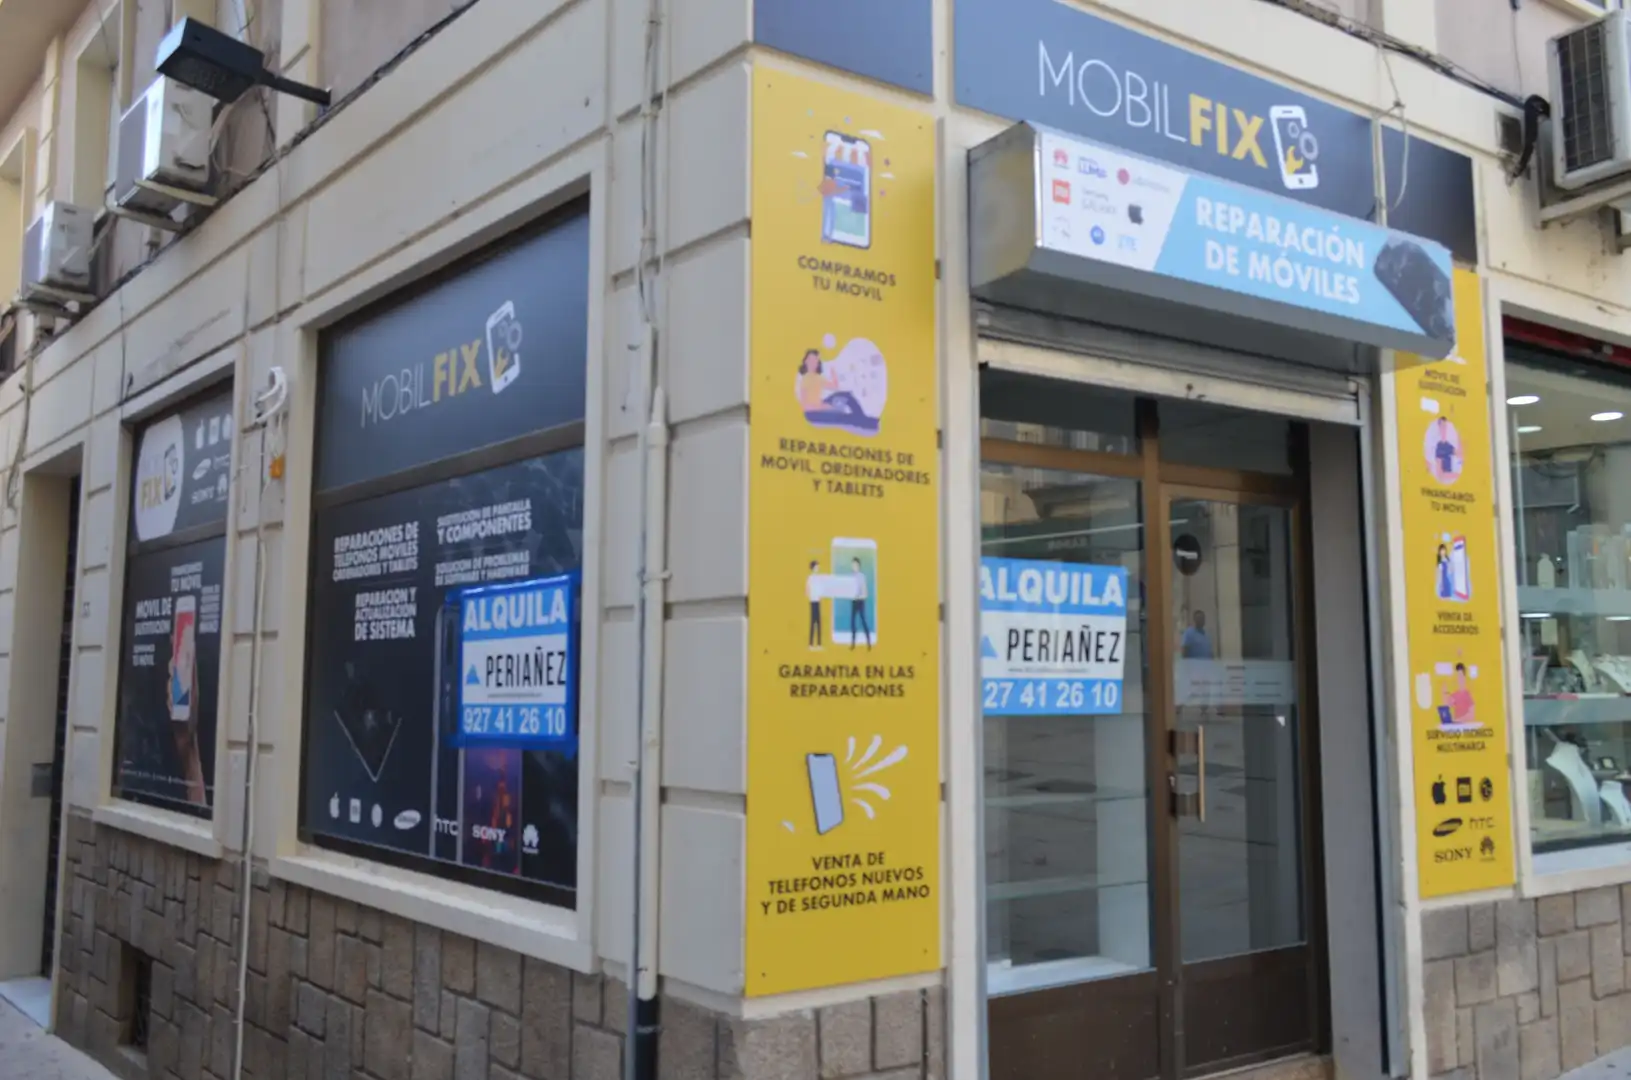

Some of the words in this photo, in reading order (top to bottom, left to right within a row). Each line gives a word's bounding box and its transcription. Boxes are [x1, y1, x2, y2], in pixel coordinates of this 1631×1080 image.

[1196, 196, 1365, 269] REPARACIÓN
[798, 255, 896, 287] COMPRAMOS
[1205, 240, 1240, 275] DE
[1249, 252, 1360, 304] MÓVILES
[812, 276, 830, 291] TU
[836, 279, 883, 302] MOVIL
[779, 437, 893, 464] REPARACIONES
[896, 452, 914, 466] DE
[821, 461, 930, 485] ORDENADORES
[813, 478, 822, 493] Y
[826, 480, 884, 499] TABLETS
[334, 524, 403, 553] REPARACIONES
[405, 521, 419, 540] DE
[437, 527, 444, 545] Y
[446, 512, 532, 544] COMPONENTES
[409, 587, 418, 602] Y
[981, 566, 1123, 607] ALQUILA
[464, 588, 567, 632] ALQUILA
[354, 622, 368, 641] DE
[369, 618, 415, 640] SISTEMA
[1006, 625, 1121, 663] PERIAÑEZ
[486, 646, 566, 688] PERIAÑEZ
[779, 664, 861, 679] GARANTIA
[866, 664, 884, 679] EN
[890, 664, 915, 679] LAS
[790, 684, 905, 698] REPARACIONES
[1019, 681, 1047, 709] 41
[1056, 682, 1084, 709] 26
[1091, 682, 1118, 708] 10
[463, 707, 491, 734] 927
[494, 707, 514, 733] 41
[519, 706, 540, 734] 26
[545, 708, 566, 735] 10
[472, 824, 506, 842] SONY
[812, 853, 862, 870] VENTA
[867, 852, 885, 866] DE
[1434, 847, 1472, 863] SONY
[768, 874, 857, 895] TELEFONOS
[862, 866, 924, 885] NUEVOS
[761, 901, 771, 915] Y
[777, 898, 796, 914] DE
[801, 890, 877, 911] SEGUNDA
[882, 885, 930, 901] MANO
